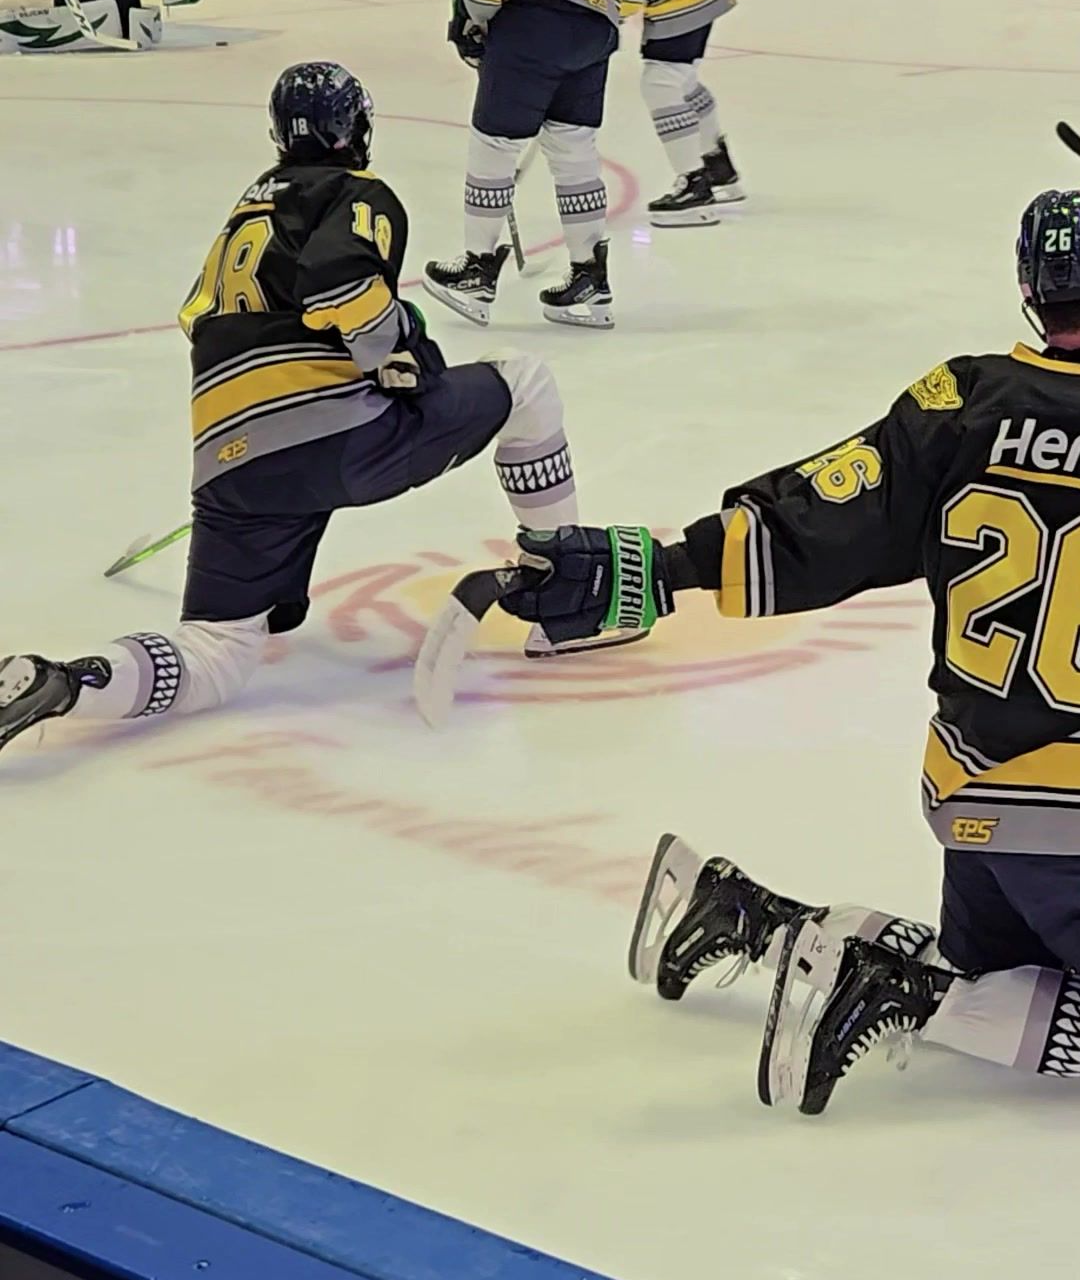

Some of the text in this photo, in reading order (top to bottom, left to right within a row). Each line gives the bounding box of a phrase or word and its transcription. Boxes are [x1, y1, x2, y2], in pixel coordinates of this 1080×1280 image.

[291, 117, 309, 136] 18
[1044, 227, 1072, 252] 26
[615, 526, 647, 629] WARRIO
